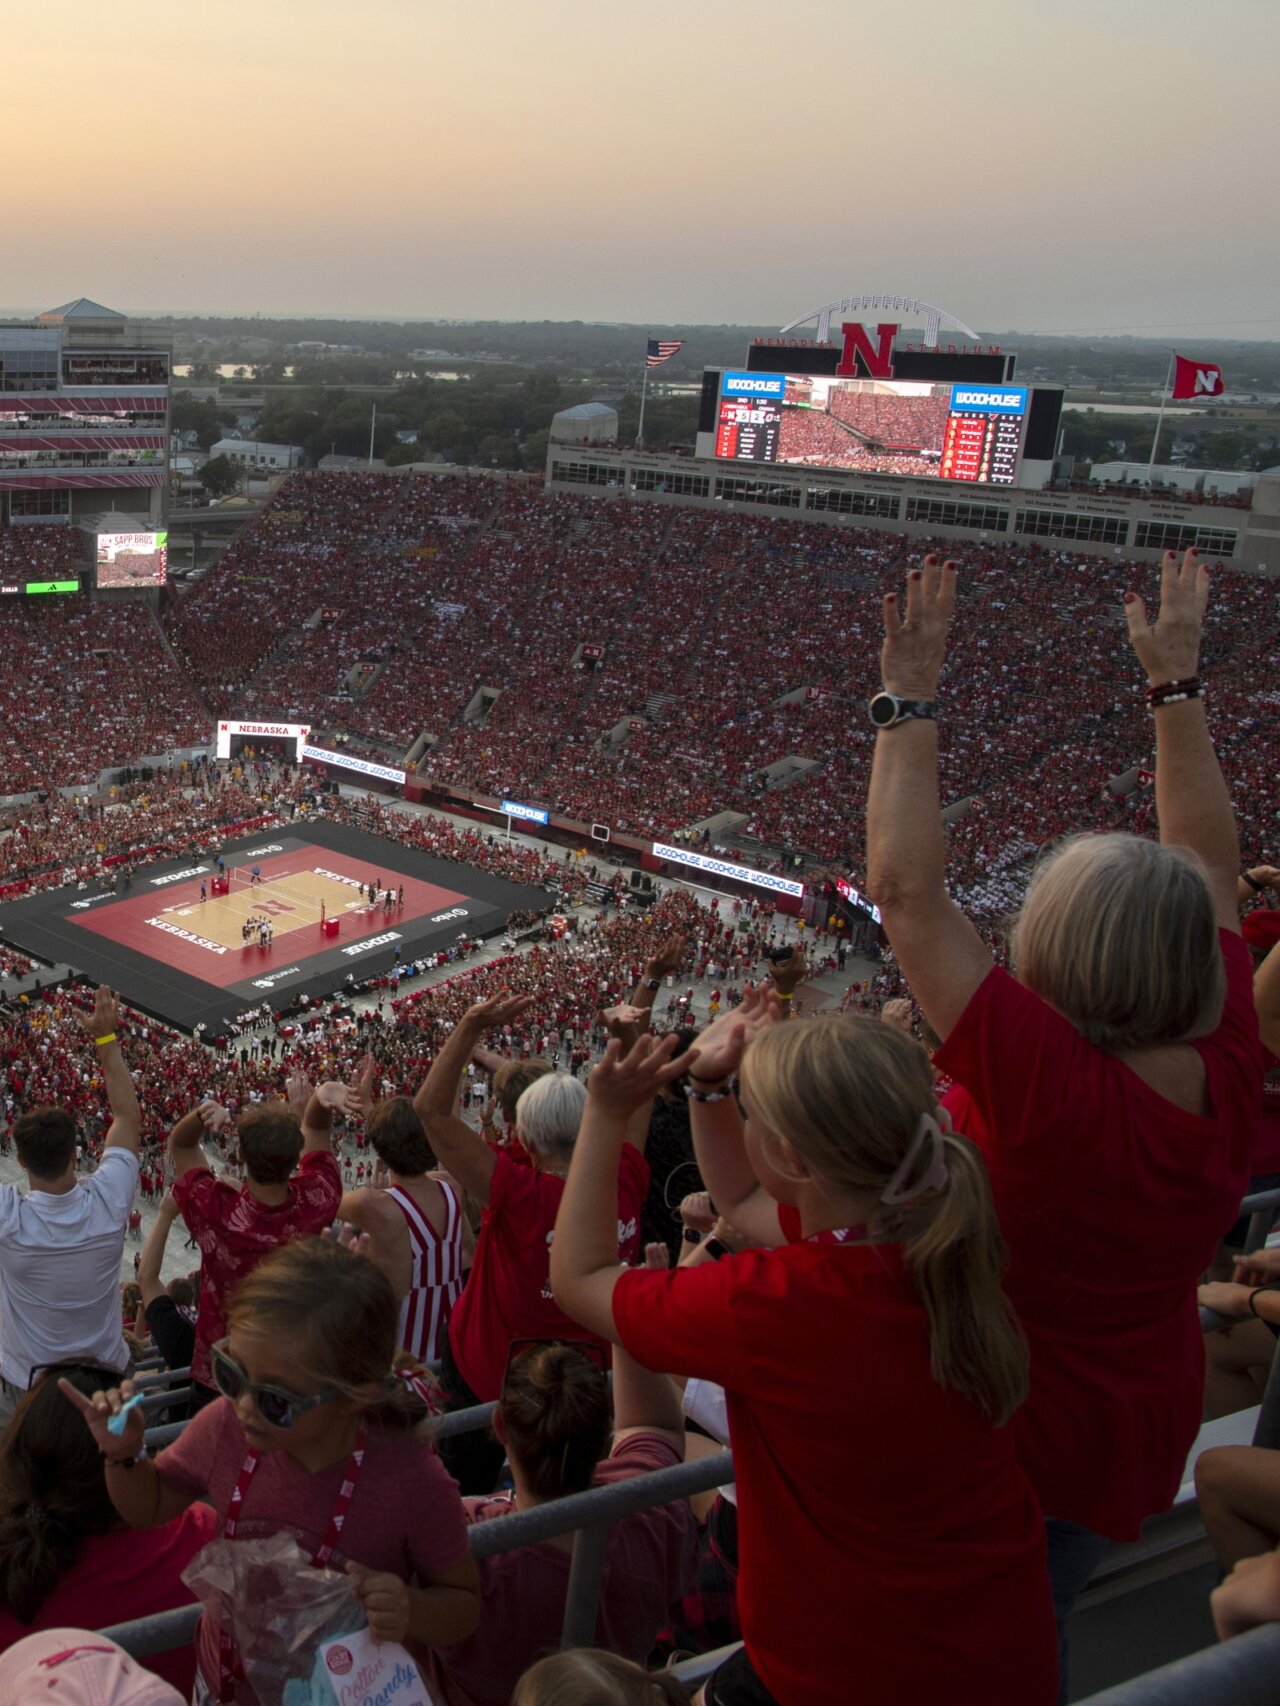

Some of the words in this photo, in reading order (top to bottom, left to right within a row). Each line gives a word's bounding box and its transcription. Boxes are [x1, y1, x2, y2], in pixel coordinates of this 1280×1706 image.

[754, 337, 835, 350] MEMORIAL
[907, 343, 1003, 356] STADIUM
[835, 323, 899, 379] N
[728, 379, 781, 392] WOODHOUSE
[1195, 369, 1219, 393] N
[956, 391, 1021, 407] WOODHOUSE
[115, 536, 133, 545] SAPP
[239, 725, 289, 735] NEBRASKA
[304, 747, 335, 762] WOODHOUSE
[336, 756, 368, 772] WOODHOUSE
[370, 765, 404, 782] WOODHOUSE
[150, 866, 210, 886] WOODHOUSE
[656, 845, 701, 866] WOODHOUSE
[703, 860, 749, 880] WOODHOUSE
[751, 873, 801, 894] WOODHOUSE
[251, 900, 297, 916] N
[144, 918, 229, 955] NEBRASKA
[341, 931, 403, 955] WOODHOUSE
[265, 966, 300, 981] Ameritas
[340, 1658, 386, 1706] Cotton
